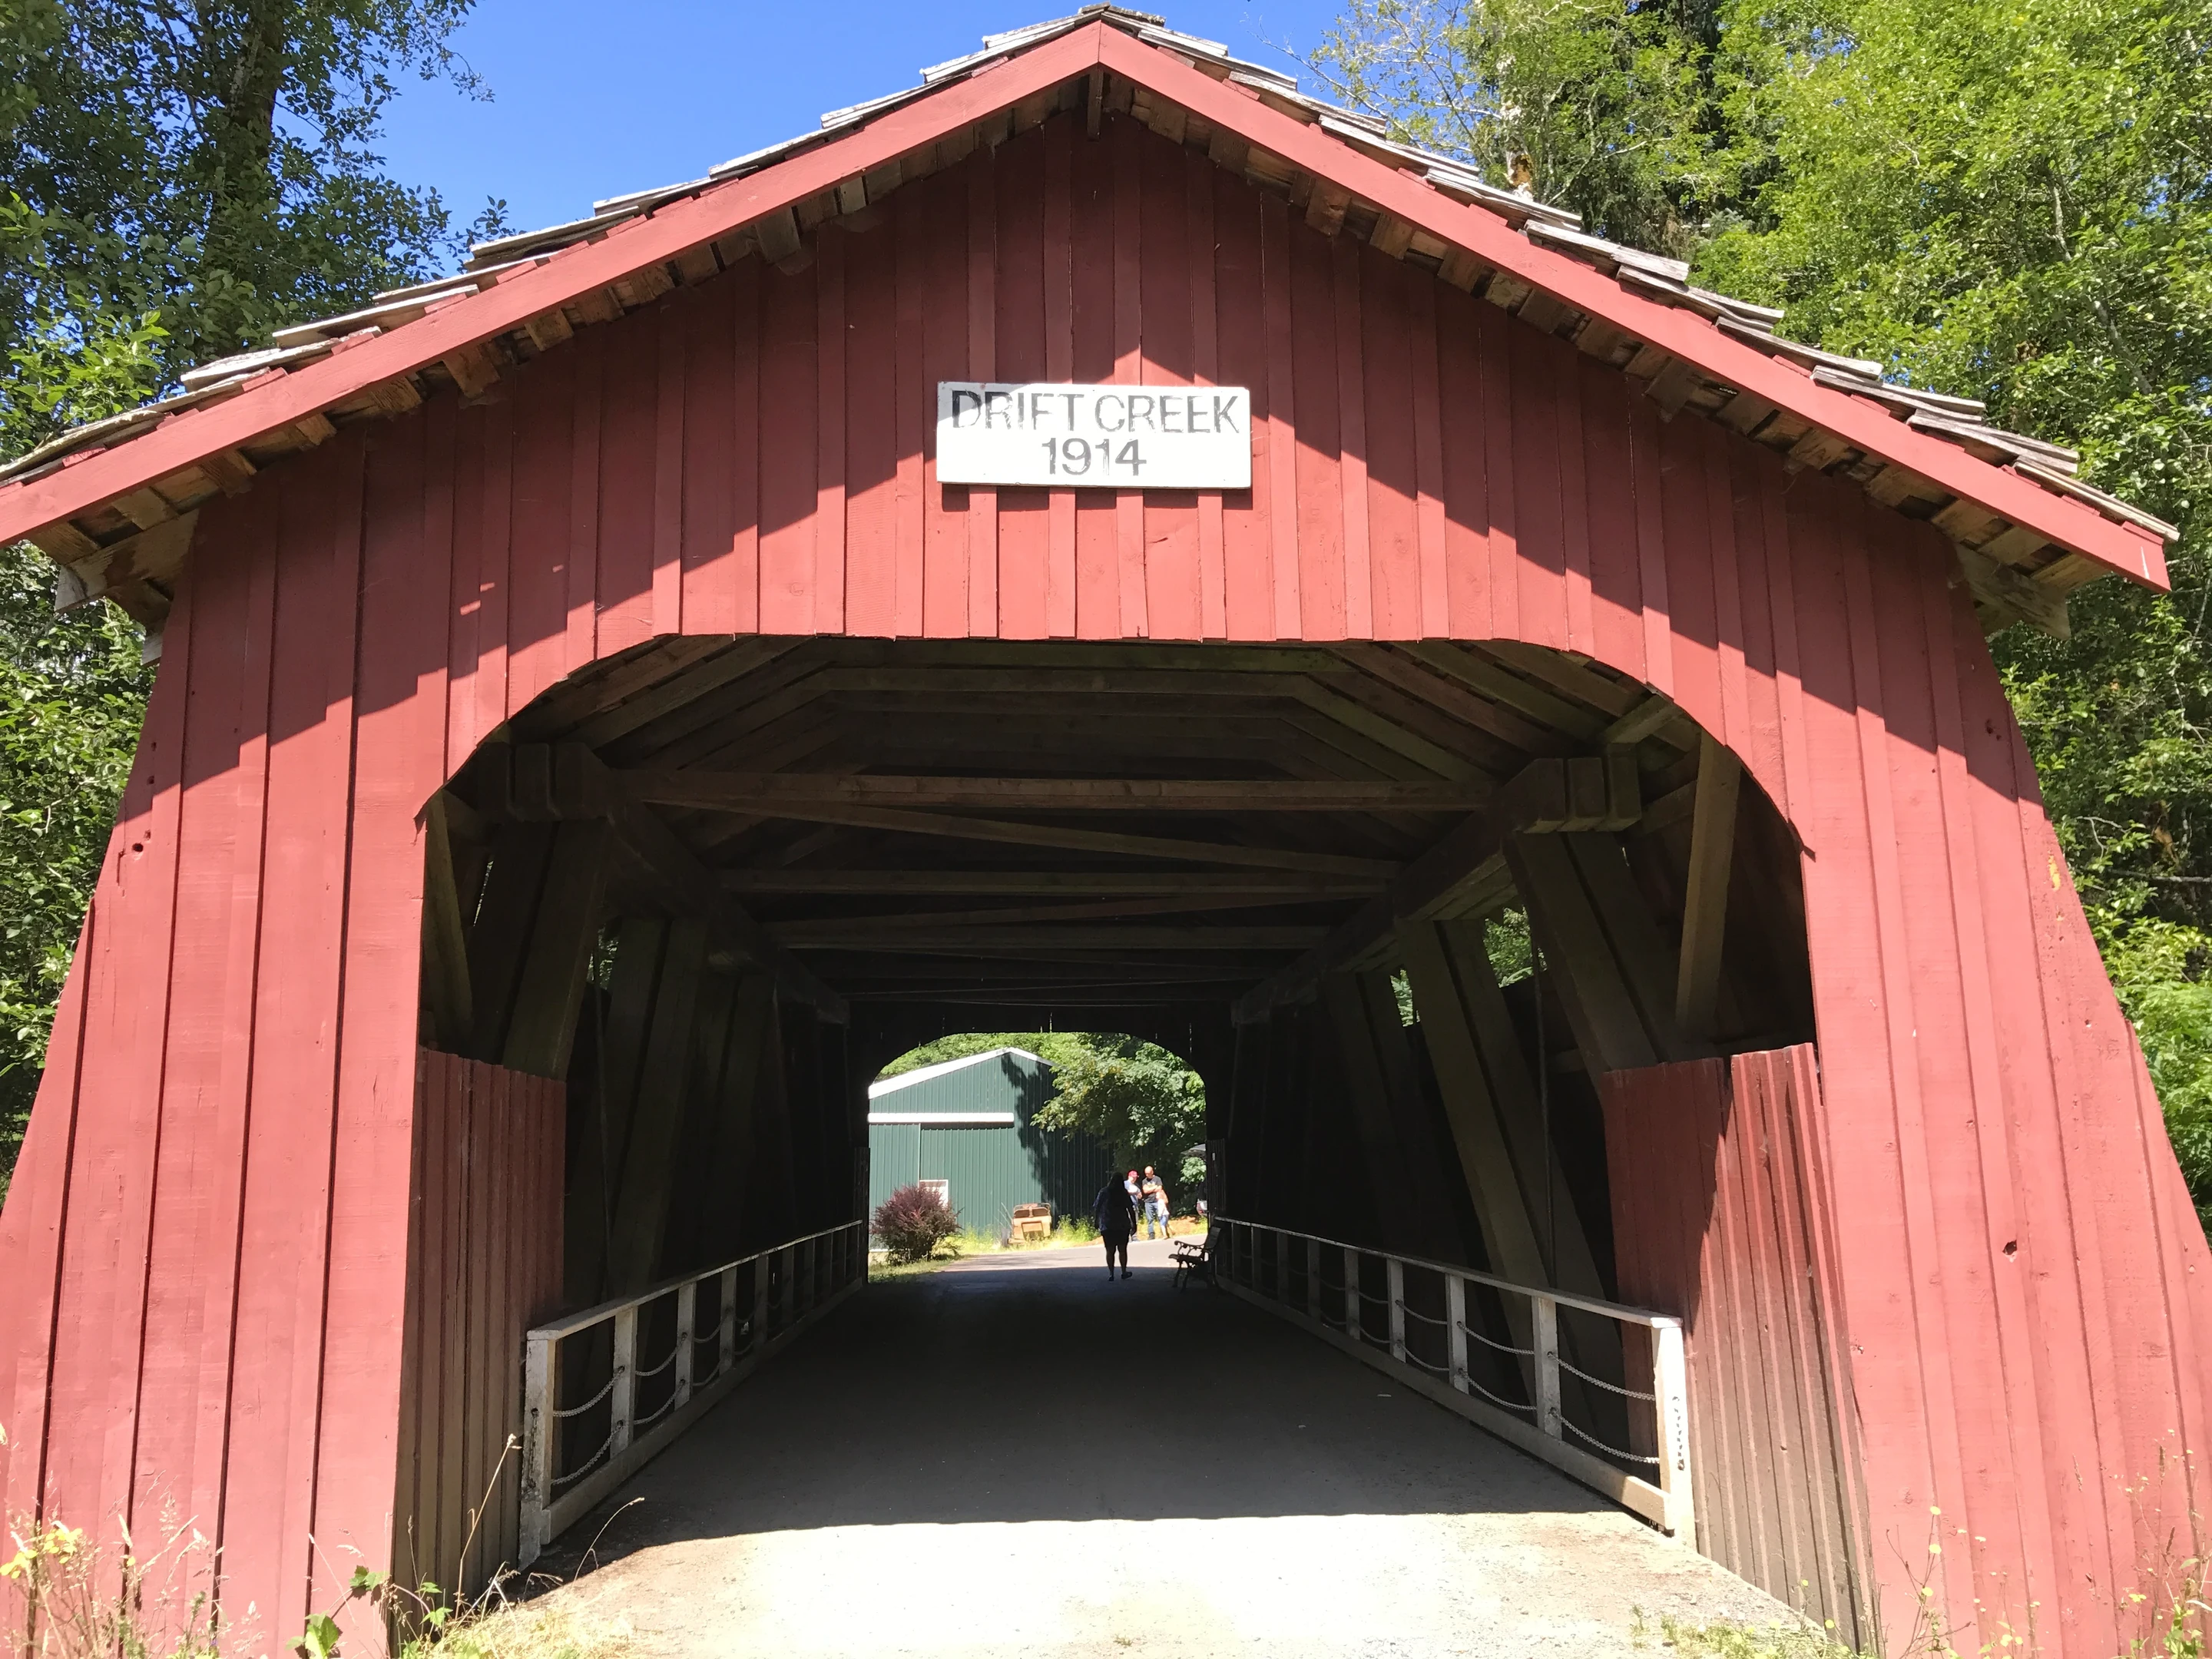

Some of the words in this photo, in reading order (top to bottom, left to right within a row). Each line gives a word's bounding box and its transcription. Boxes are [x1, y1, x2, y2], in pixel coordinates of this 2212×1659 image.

[952, 389, 1084, 432] DRIFT
[1094, 395, 1240, 434] CREEK
[1042, 438, 1147, 476] 1914
